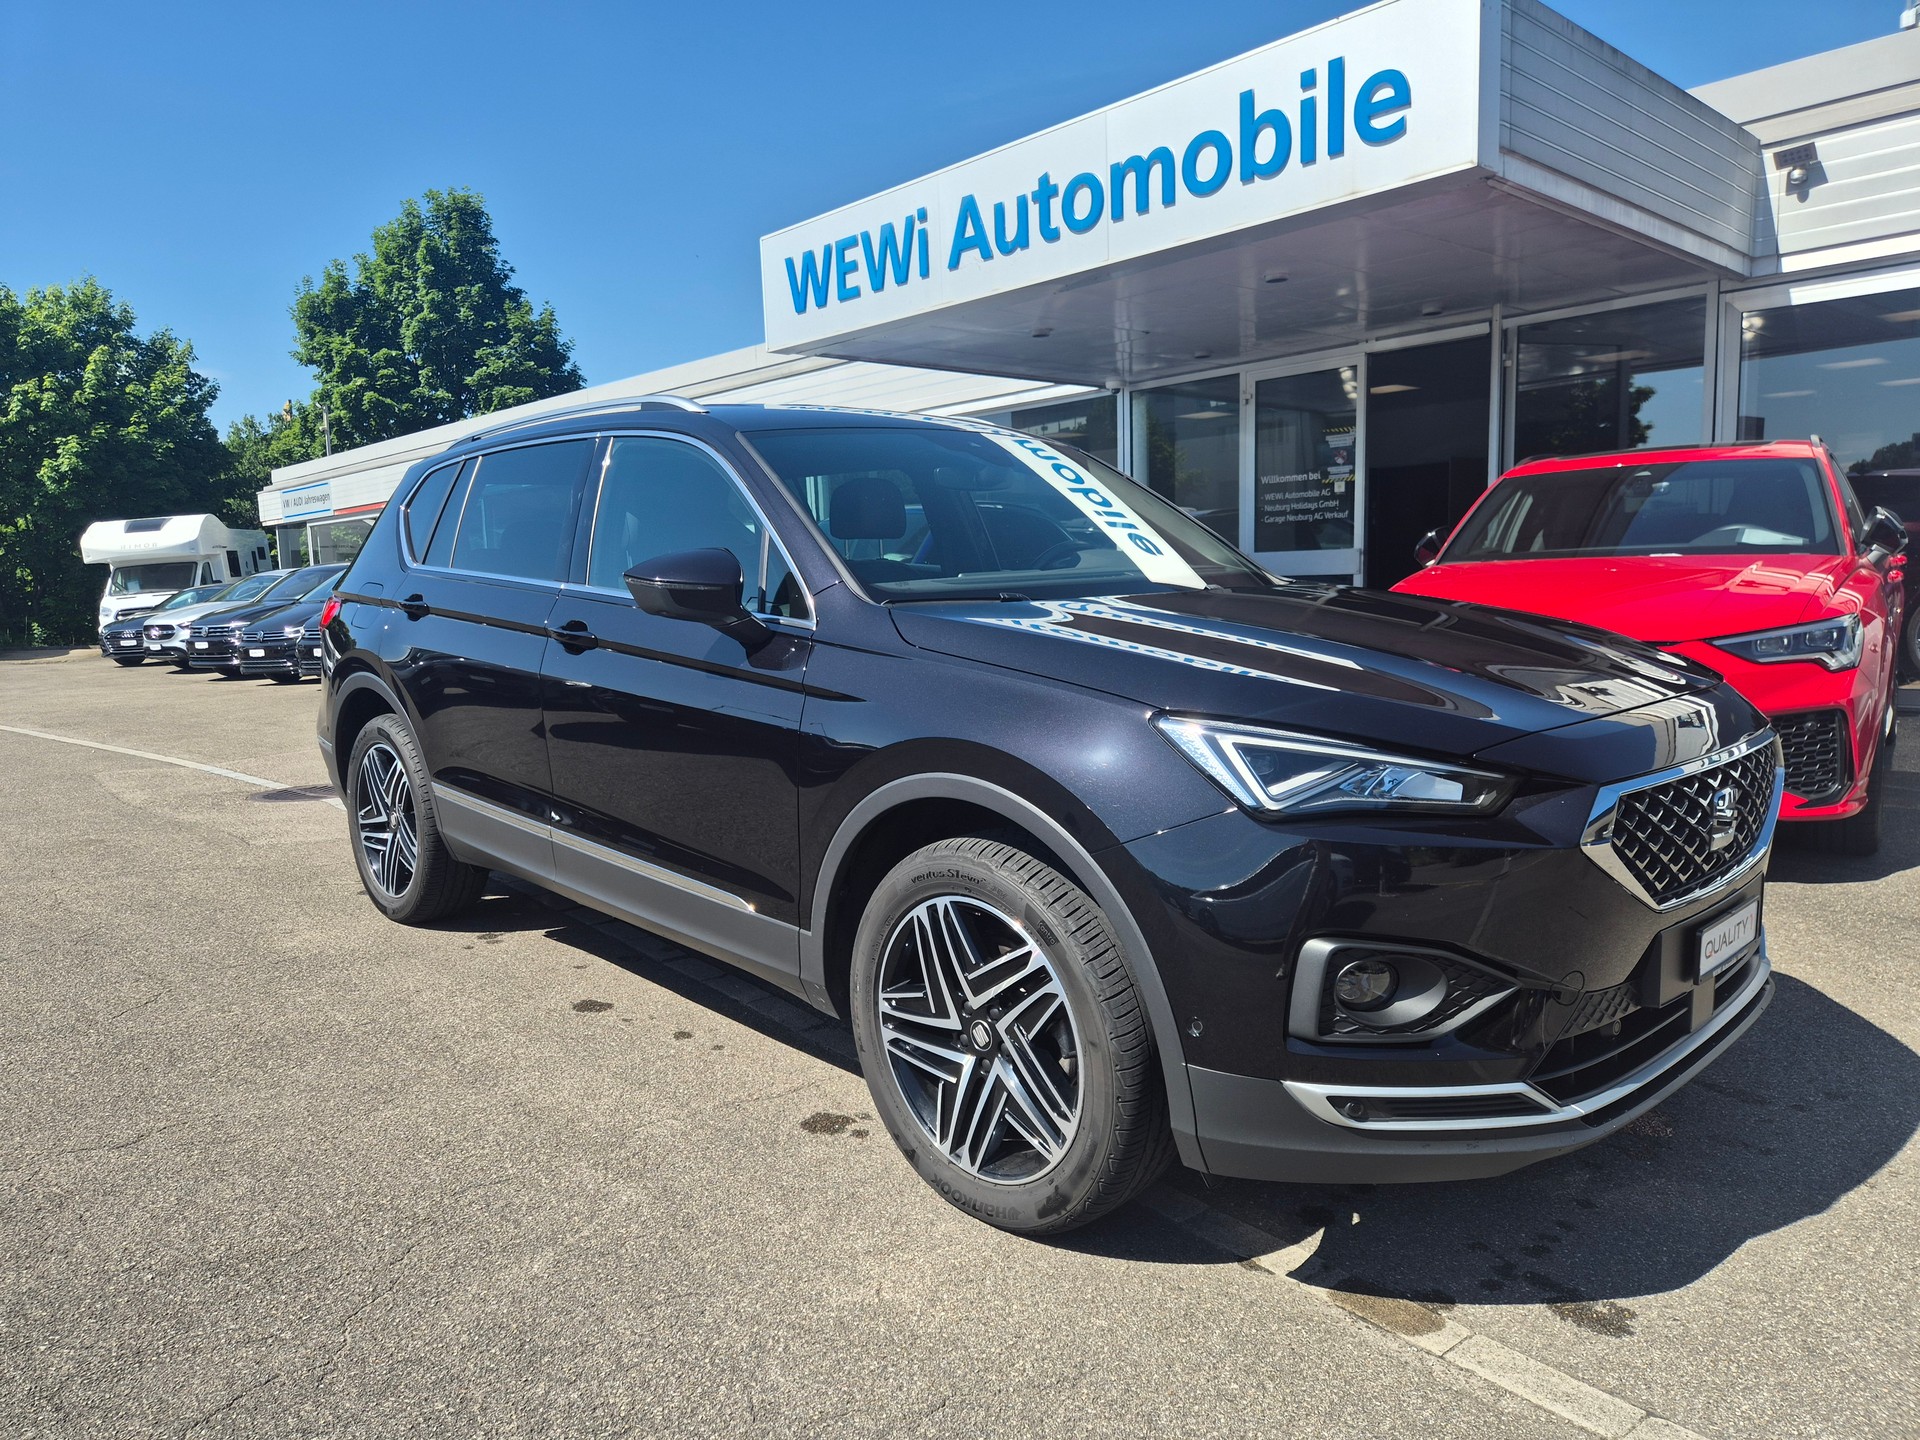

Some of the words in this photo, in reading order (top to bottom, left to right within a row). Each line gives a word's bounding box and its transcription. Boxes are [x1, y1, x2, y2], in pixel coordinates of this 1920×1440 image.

[784, 208, 930, 315] WEWi
[947, 56, 1412, 270] Automobile
[1261, 474, 1307, 484] Willkommen
[1308, 470, 1321, 481] bei
[283, 499, 291, 509] VW
[293, 497, 304, 507] AUDI
[304, 493, 331, 505] Jahreswagen
[1265, 493, 1284, 501] WEWi
[1285, 490, 1320, 499] Automobile
[1321, 488, 1331, 496] AG
[1265, 503, 1291, 512] Neuburg
[1291, 501, 1318, 510] Holidays
[1265, 515, 1286, 524] Garage
[1286, 514, 1313, 522] Neuburg
[1314, 512, 1323, 520] AG
[1324, 510, 1349, 519] Verkauf
